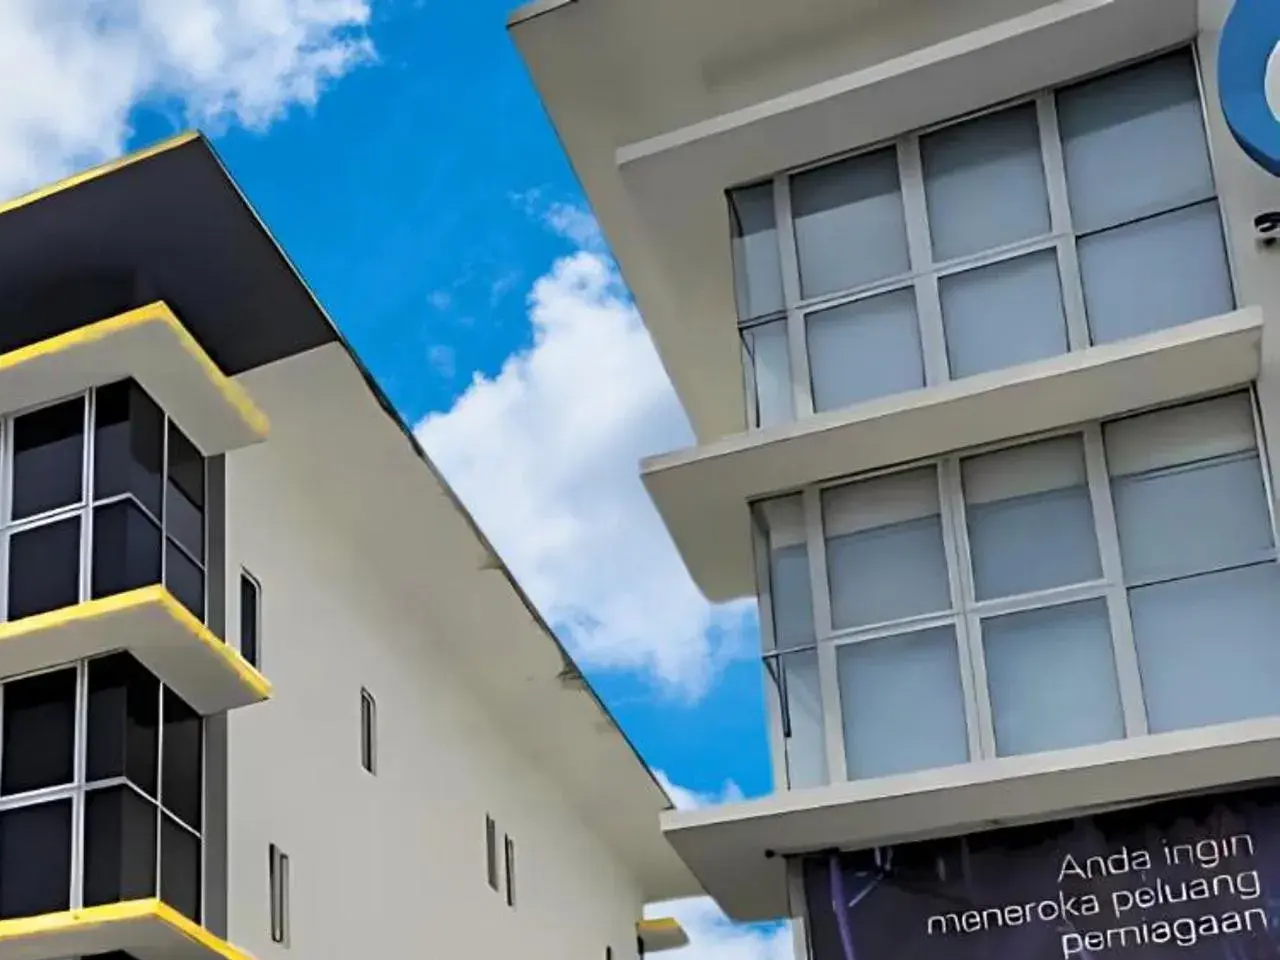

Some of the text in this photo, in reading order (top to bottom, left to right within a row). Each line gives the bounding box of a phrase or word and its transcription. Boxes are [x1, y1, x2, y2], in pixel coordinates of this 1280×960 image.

[1057, 833, 1255, 884] Anda ingin
[926, 869, 1262, 935] meneroka peluang
